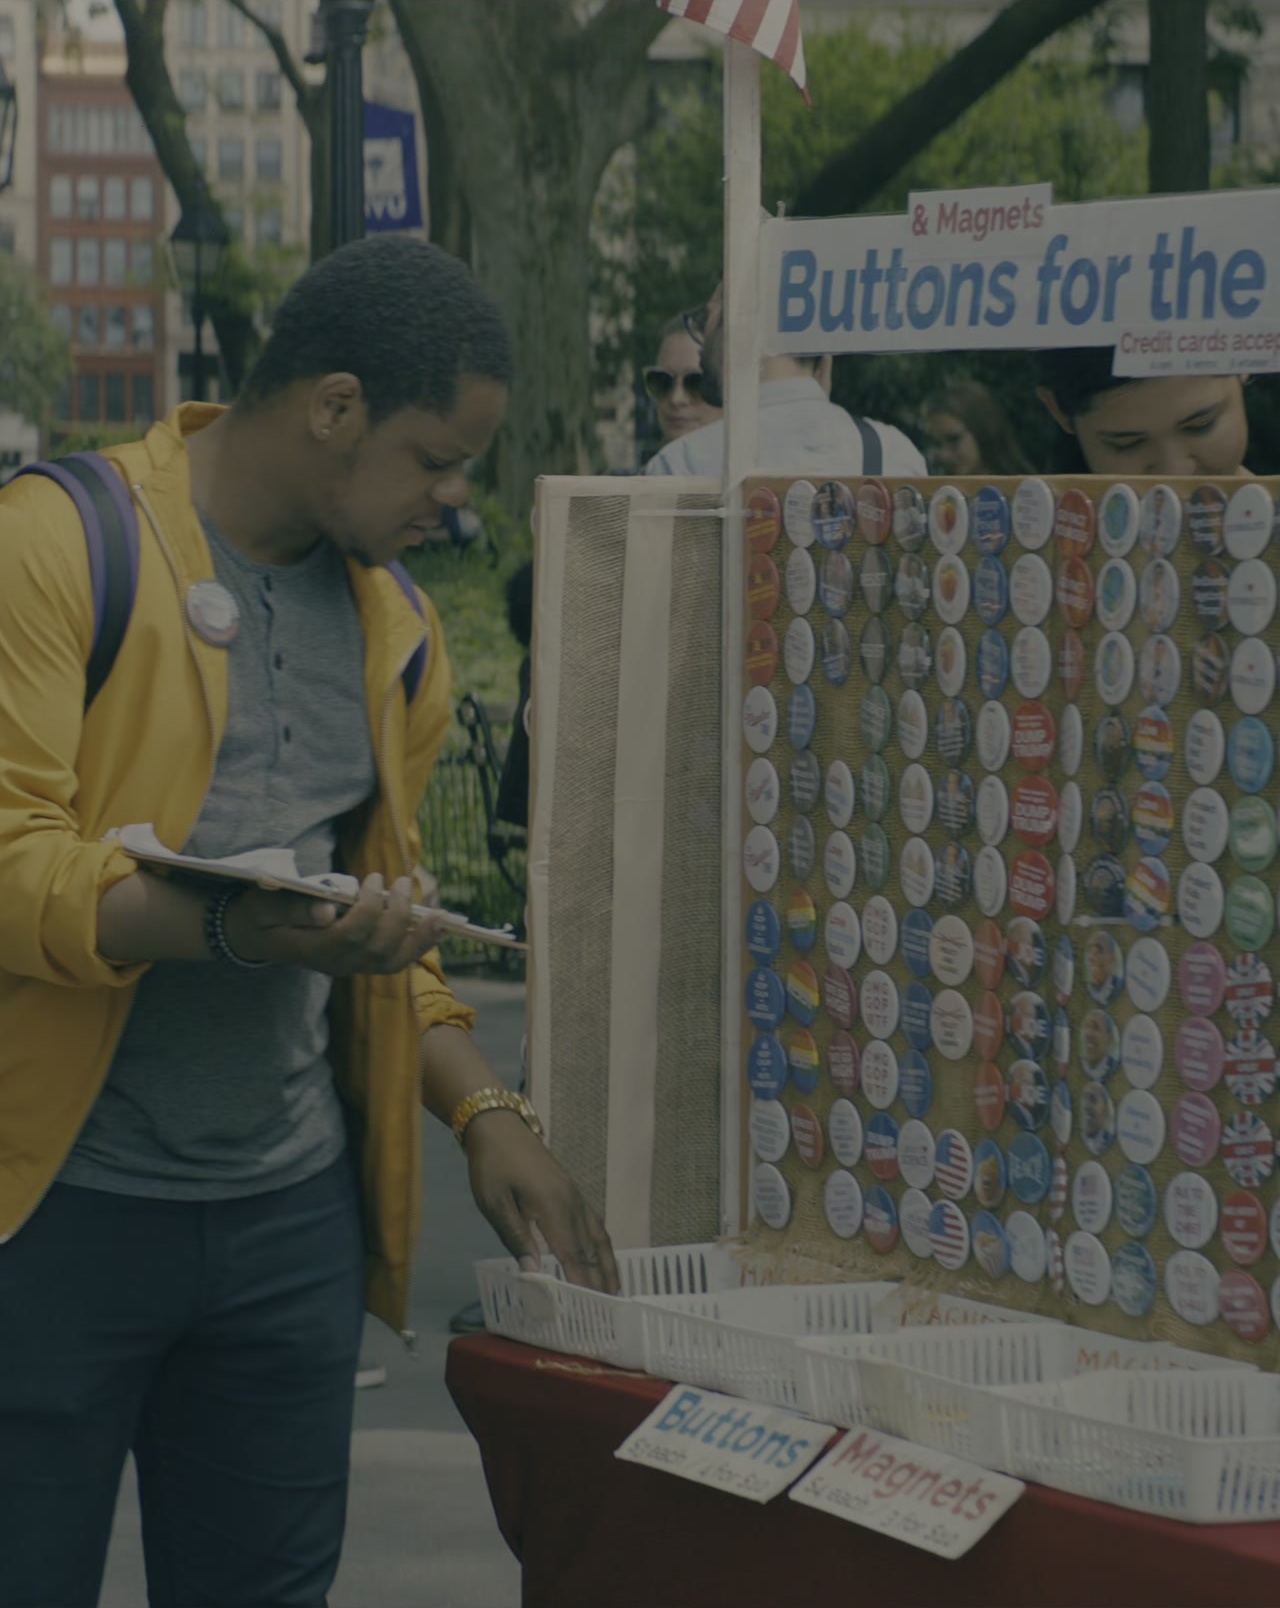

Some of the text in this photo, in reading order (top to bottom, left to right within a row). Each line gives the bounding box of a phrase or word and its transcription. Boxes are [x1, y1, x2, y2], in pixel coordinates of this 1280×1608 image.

[912, 197, 1044, 242] & Magnets
[777, 248, 1019, 332] Buttons
[1037, 233, 1132, 325] for
[1149, 226, 1267, 321] the
[1120, 329, 1173, 355] Credit
[1176, 328, 1228, 353] cards
[654, 1391, 810, 1469] Buttons
[831, 1431, 997, 1521] Magnets
